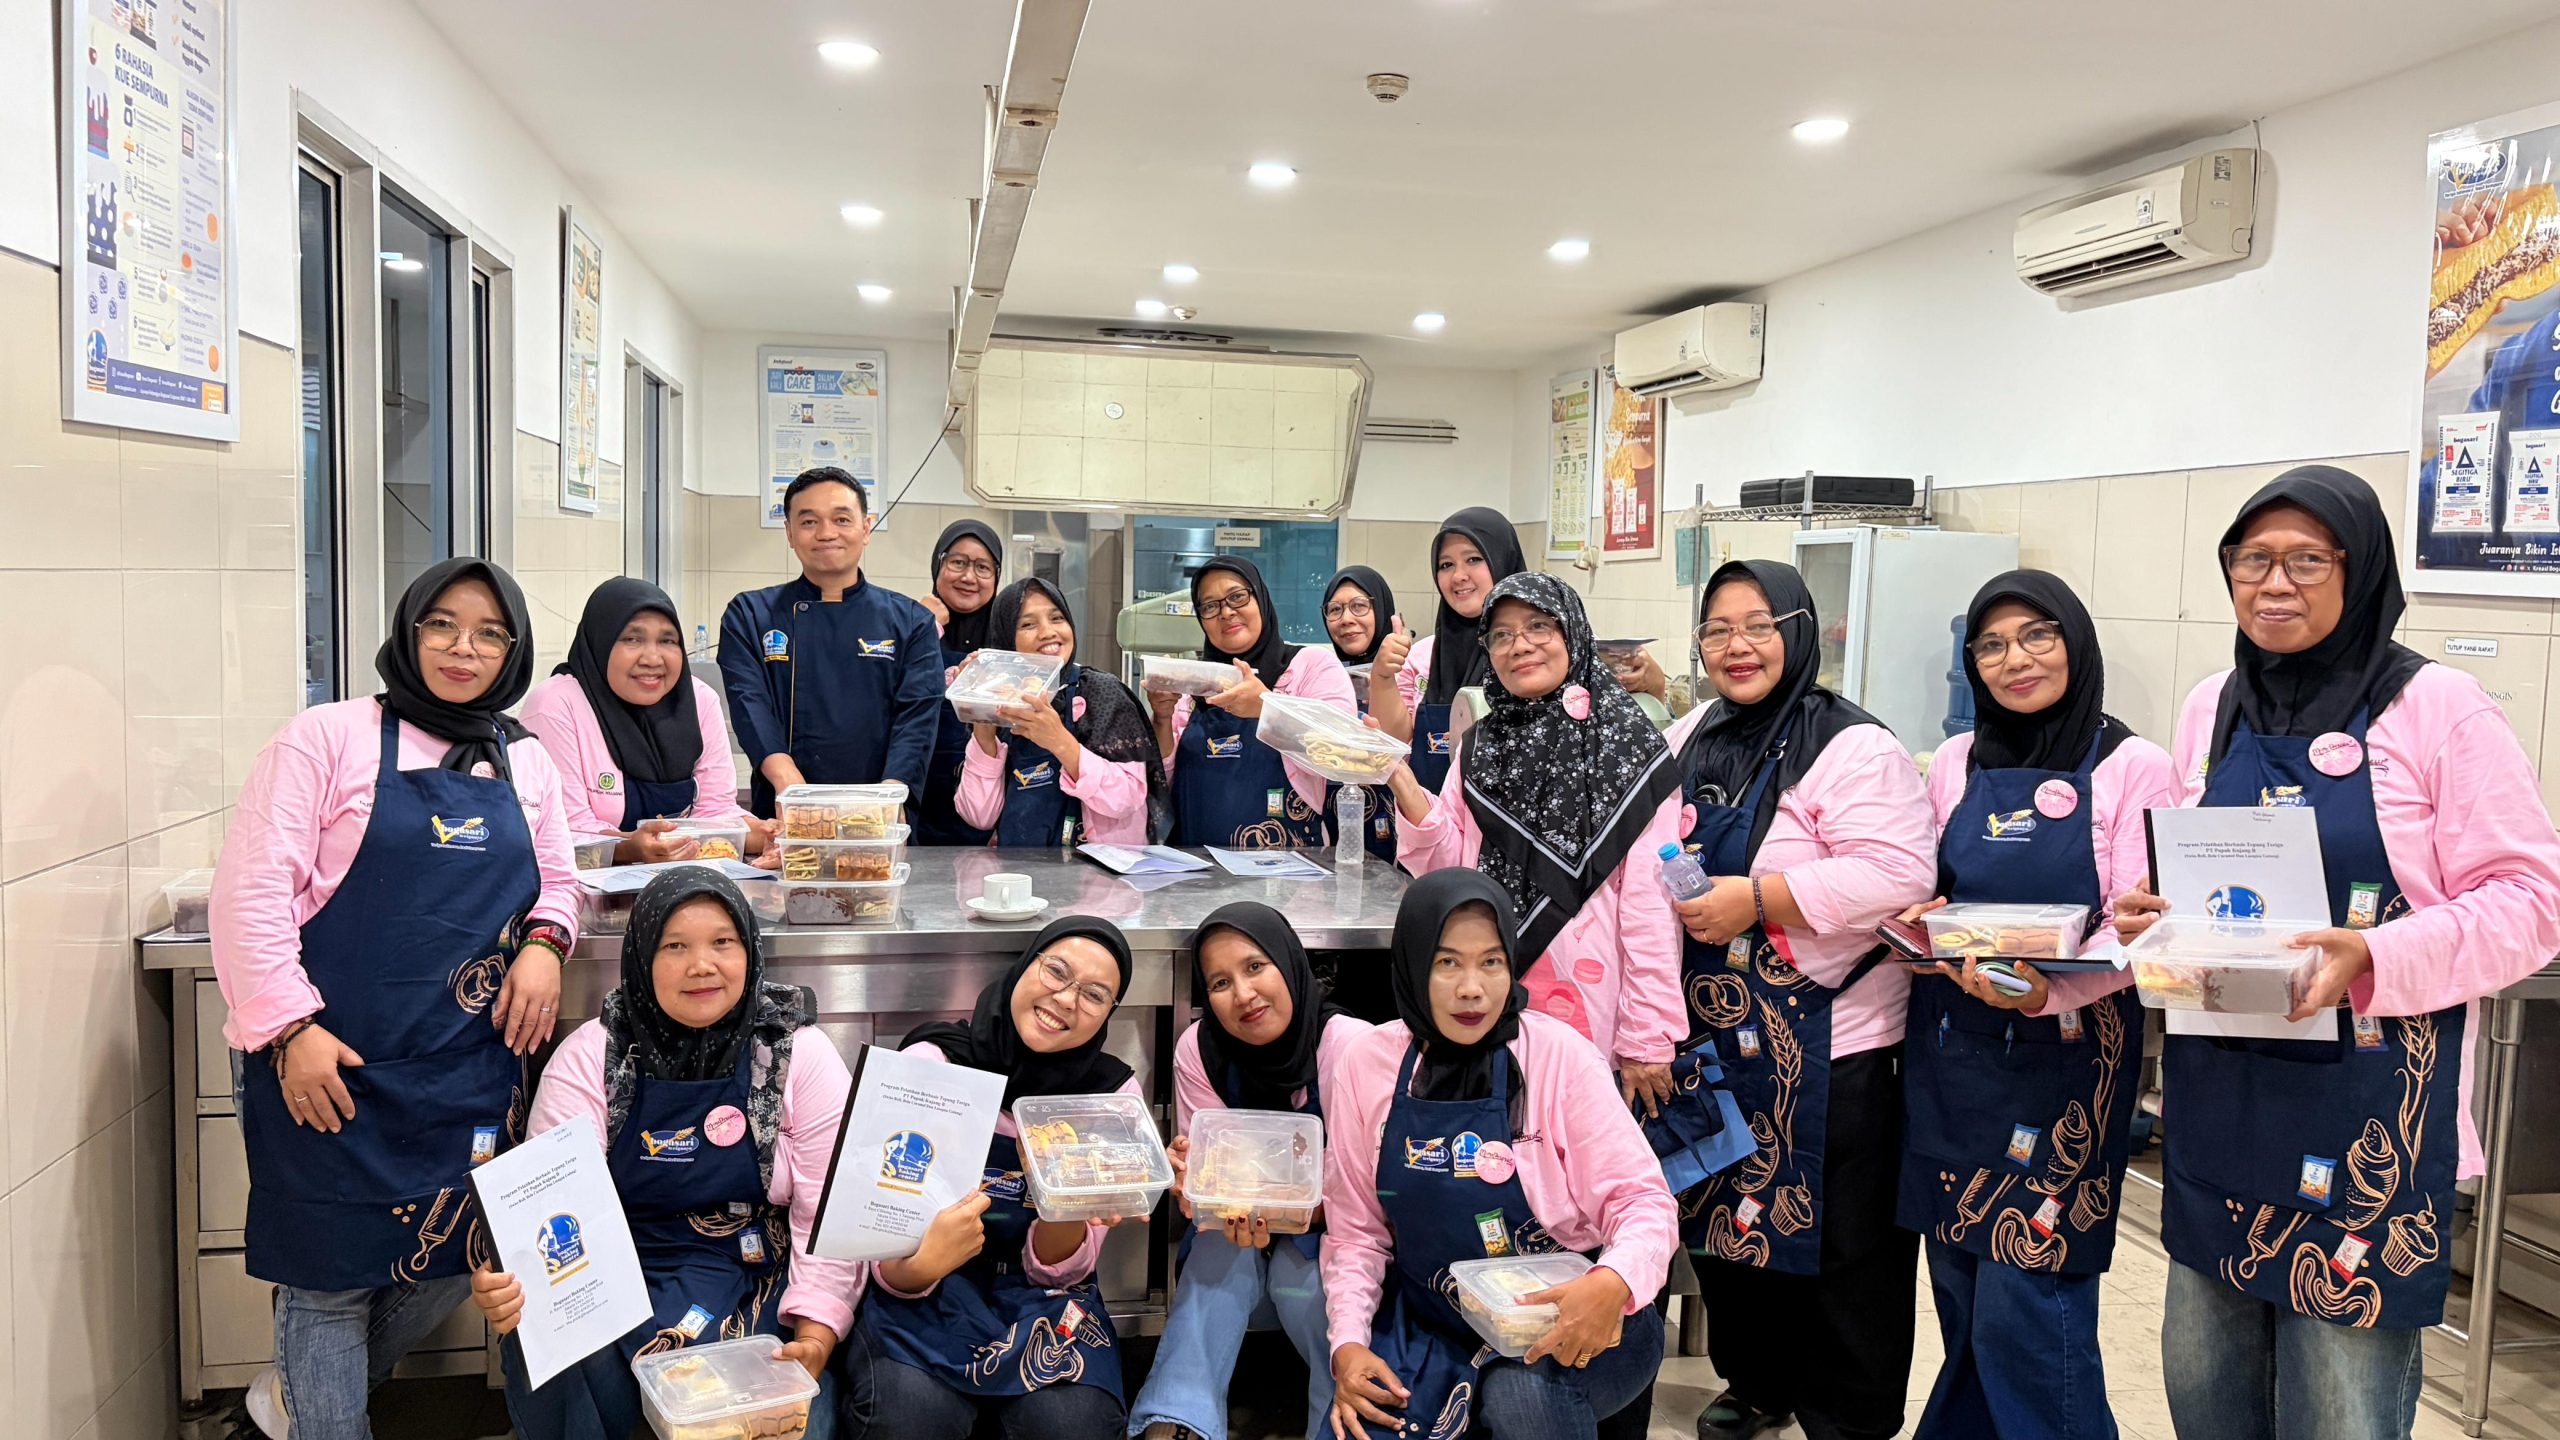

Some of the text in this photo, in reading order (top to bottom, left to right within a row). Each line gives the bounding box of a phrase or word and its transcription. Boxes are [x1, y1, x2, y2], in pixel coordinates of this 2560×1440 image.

[115, 43, 121, 60] 6
[122, 47, 154, 81] RAHASIA
[115, 64, 169, 109] KUE SEMPURNA
[786, 376, 812, 390] CAKE
[2451, 468, 2478, 476] SEGITIGA
[2479, 542, 2521, 558] Juaranya
[2525, 542, 2547, 555] Bikin
[1019, 769, 1050, 779] bogasari
[1996, 818, 2032, 829] bogasari
[441, 824, 484, 836] bogasari
[880, 1082, 900, 1091] Program
[650, 1137, 694, 1149] bogasari
[1410, 1146, 1445, 1157] bogasari
[899, 1168, 920, 1177] baking
[500, 1189, 518, 1201] Program
[870, 1201, 890, 1209] Bogasari
[890, 1205, 905, 1213] Baking
[560, 1248, 579, 1260] baking
